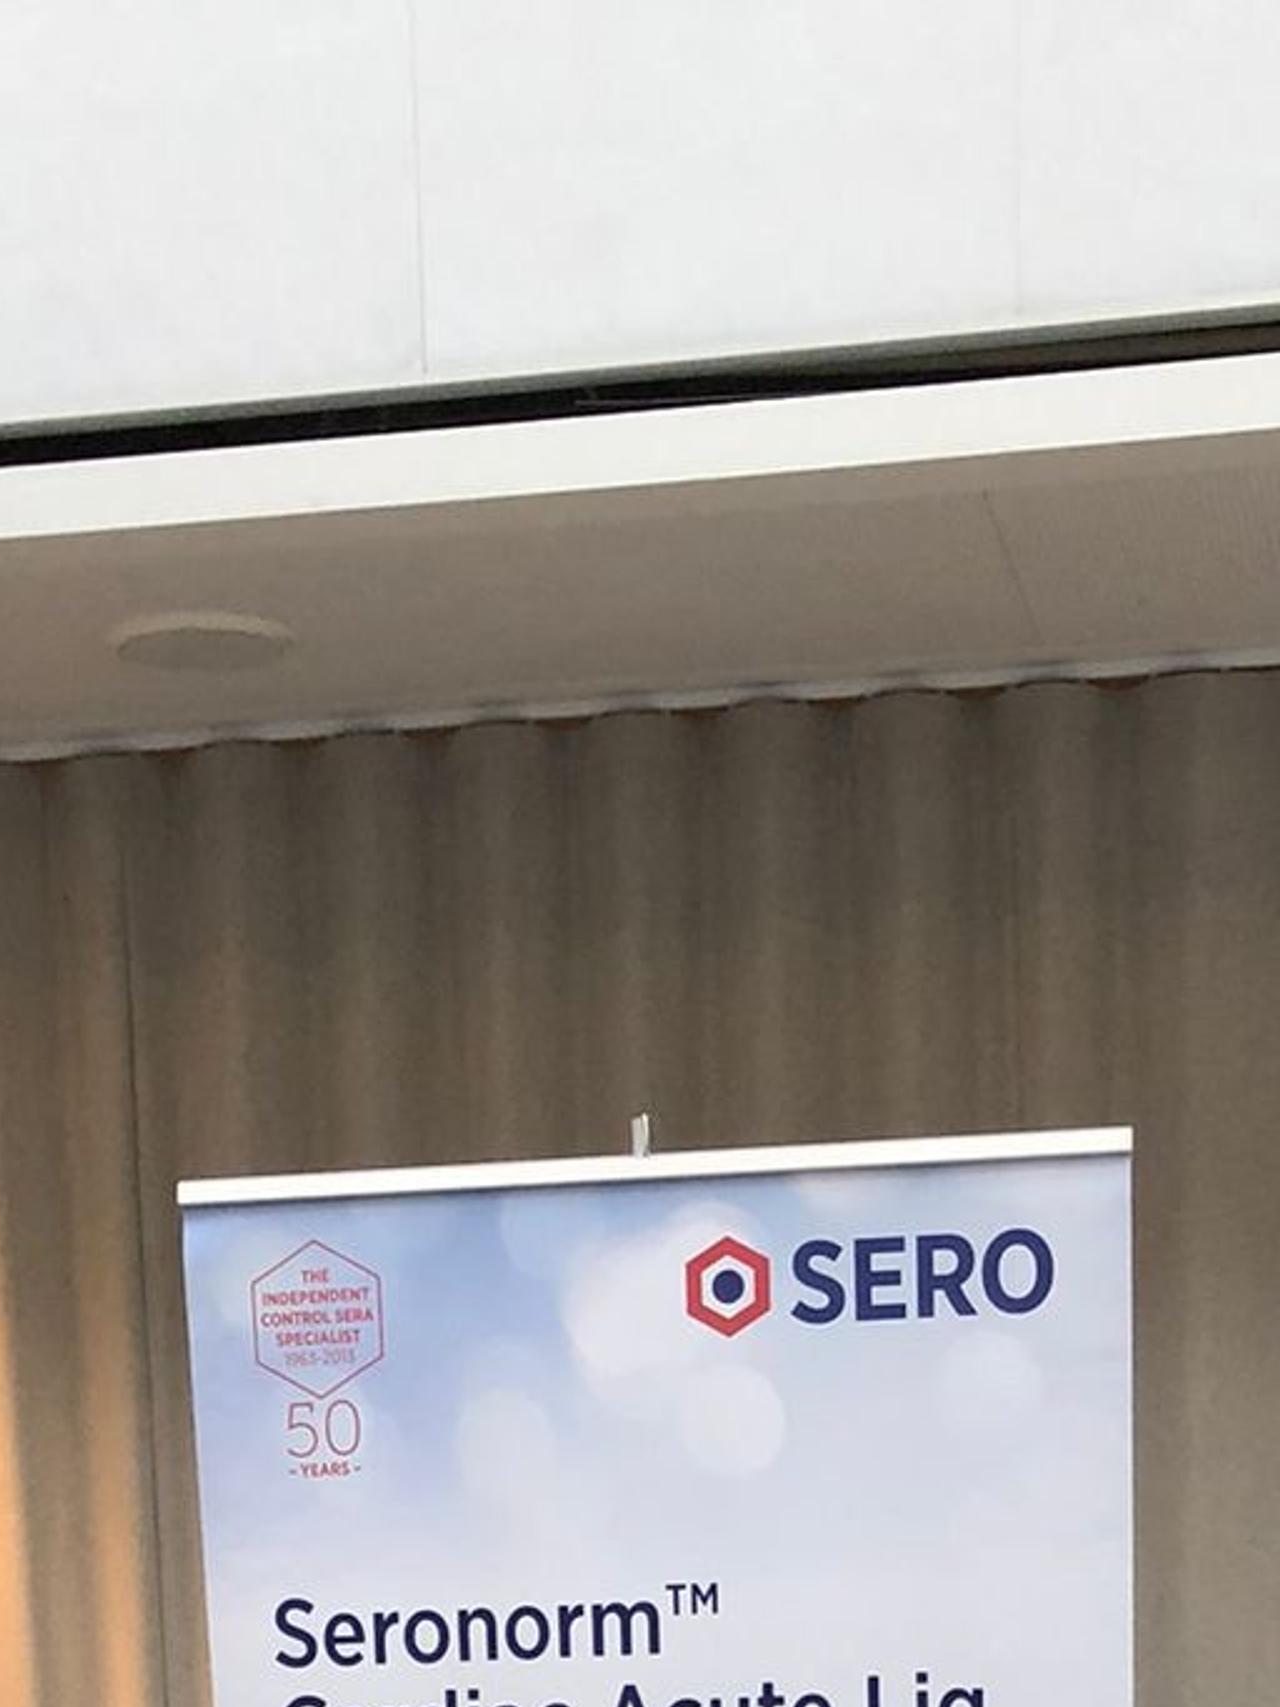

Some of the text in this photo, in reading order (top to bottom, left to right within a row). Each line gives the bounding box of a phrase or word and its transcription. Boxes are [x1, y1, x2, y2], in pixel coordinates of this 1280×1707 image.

[301, 1269, 329, 1284] THE
[790, 1228, 1054, 1325] SERO
[261, 1287, 370, 1306] INDEPENDENT
[260, 1308, 374, 1328] CONTROL SERA
[274, 1329, 361, 1347] SPECIALIST
[287, 1398, 361, 1458] 50
[300, 1461, 351, 1478] YEARS
